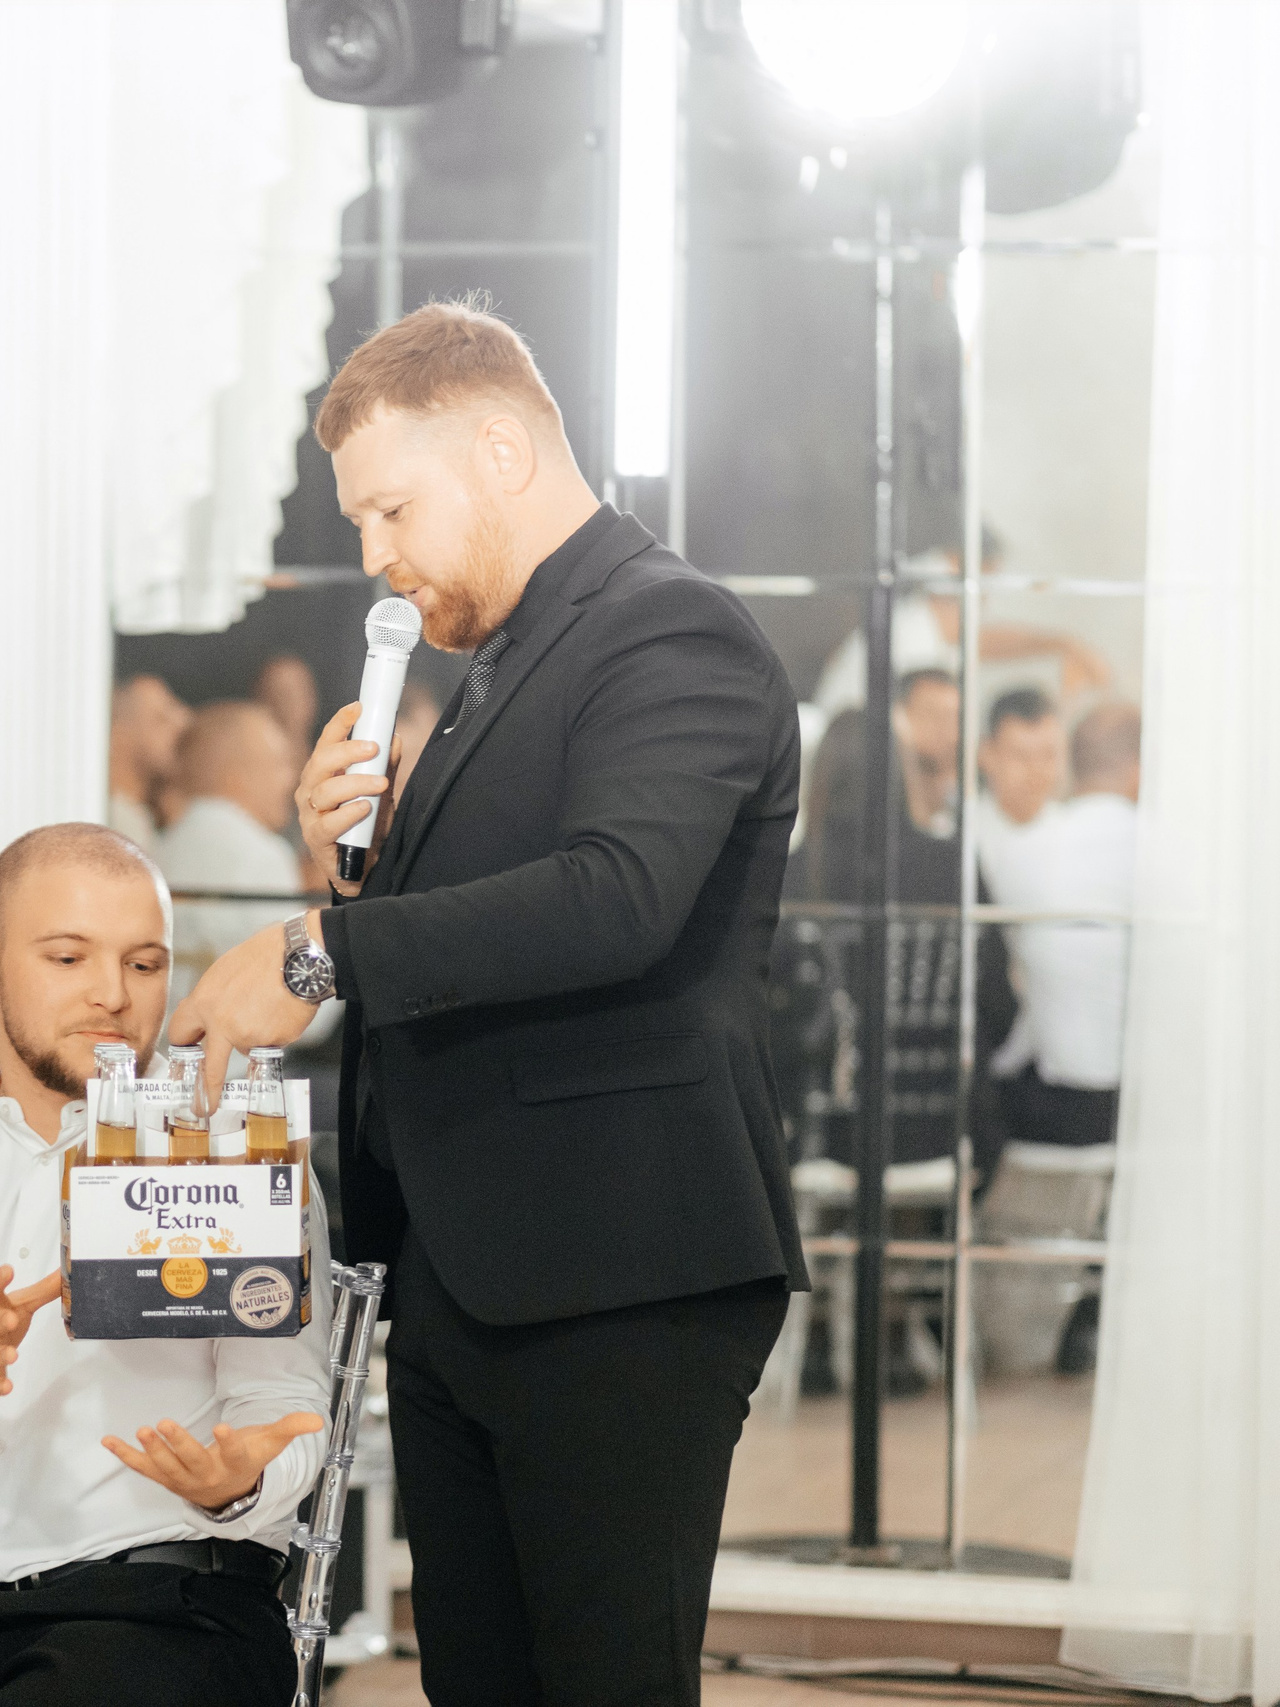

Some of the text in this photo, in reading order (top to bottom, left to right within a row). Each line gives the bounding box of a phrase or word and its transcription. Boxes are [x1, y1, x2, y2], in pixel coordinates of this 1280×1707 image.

[276, 1173, 287, 1189] 6
[124, 1177, 239, 1215] Corona
[156, 1208, 216, 1229] Extra
[136, 1268, 228, 1277] DESDE 1925
[166, 1268, 203, 1276] CERVEZA
[241, 1284, 282, 1298] INGREDIENTES
[236, 1291, 290, 1310] NATURALES
